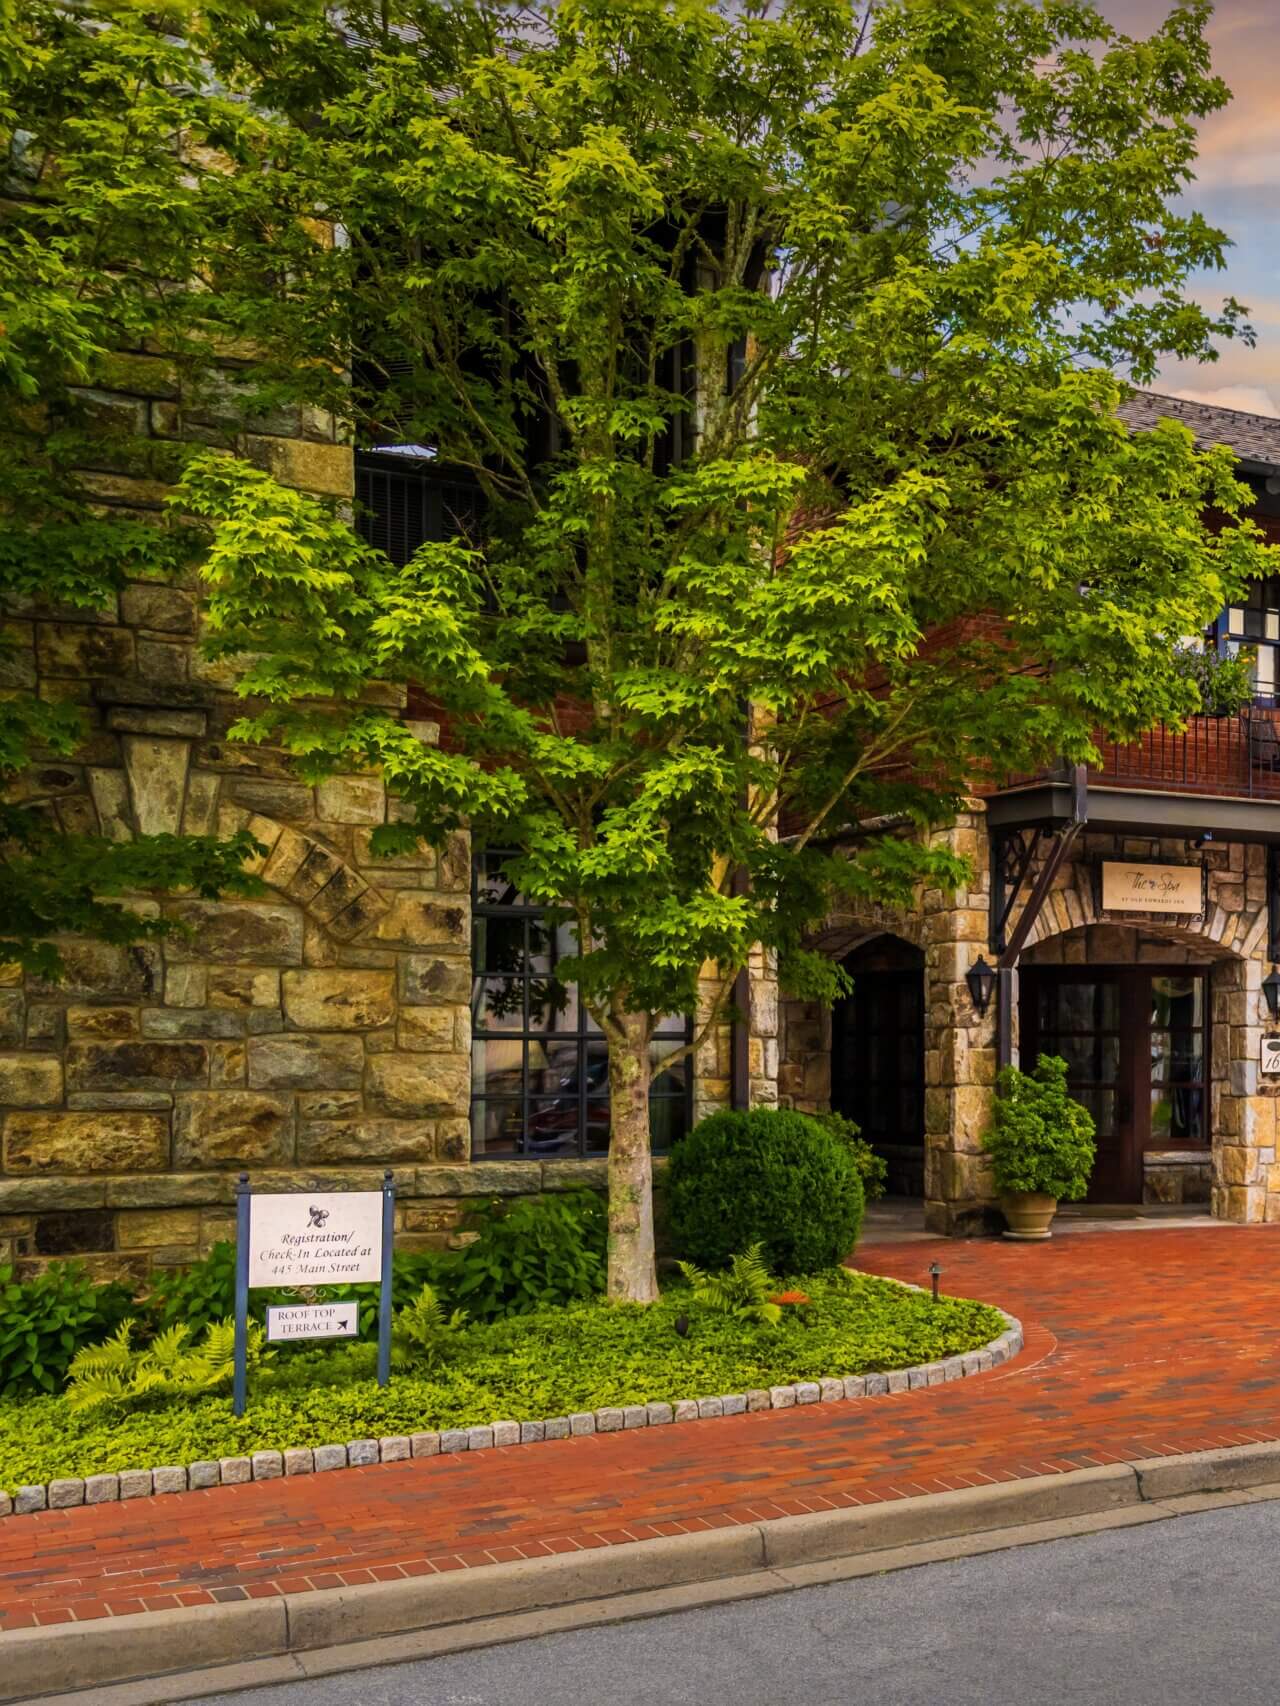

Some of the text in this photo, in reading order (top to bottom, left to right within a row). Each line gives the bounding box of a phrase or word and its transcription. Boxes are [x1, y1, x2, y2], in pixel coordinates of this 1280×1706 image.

[1124, 871, 1182, 896] The Spa
[281, 1230, 356, 1246] Registration/
[259, 1245, 372, 1261] Check-In Located at
[271, 1262, 360, 1275] 445 Main Street
[278, 1308, 336, 1320] ROOF TOP
[281, 1321, 333, 1333] TERRACE
